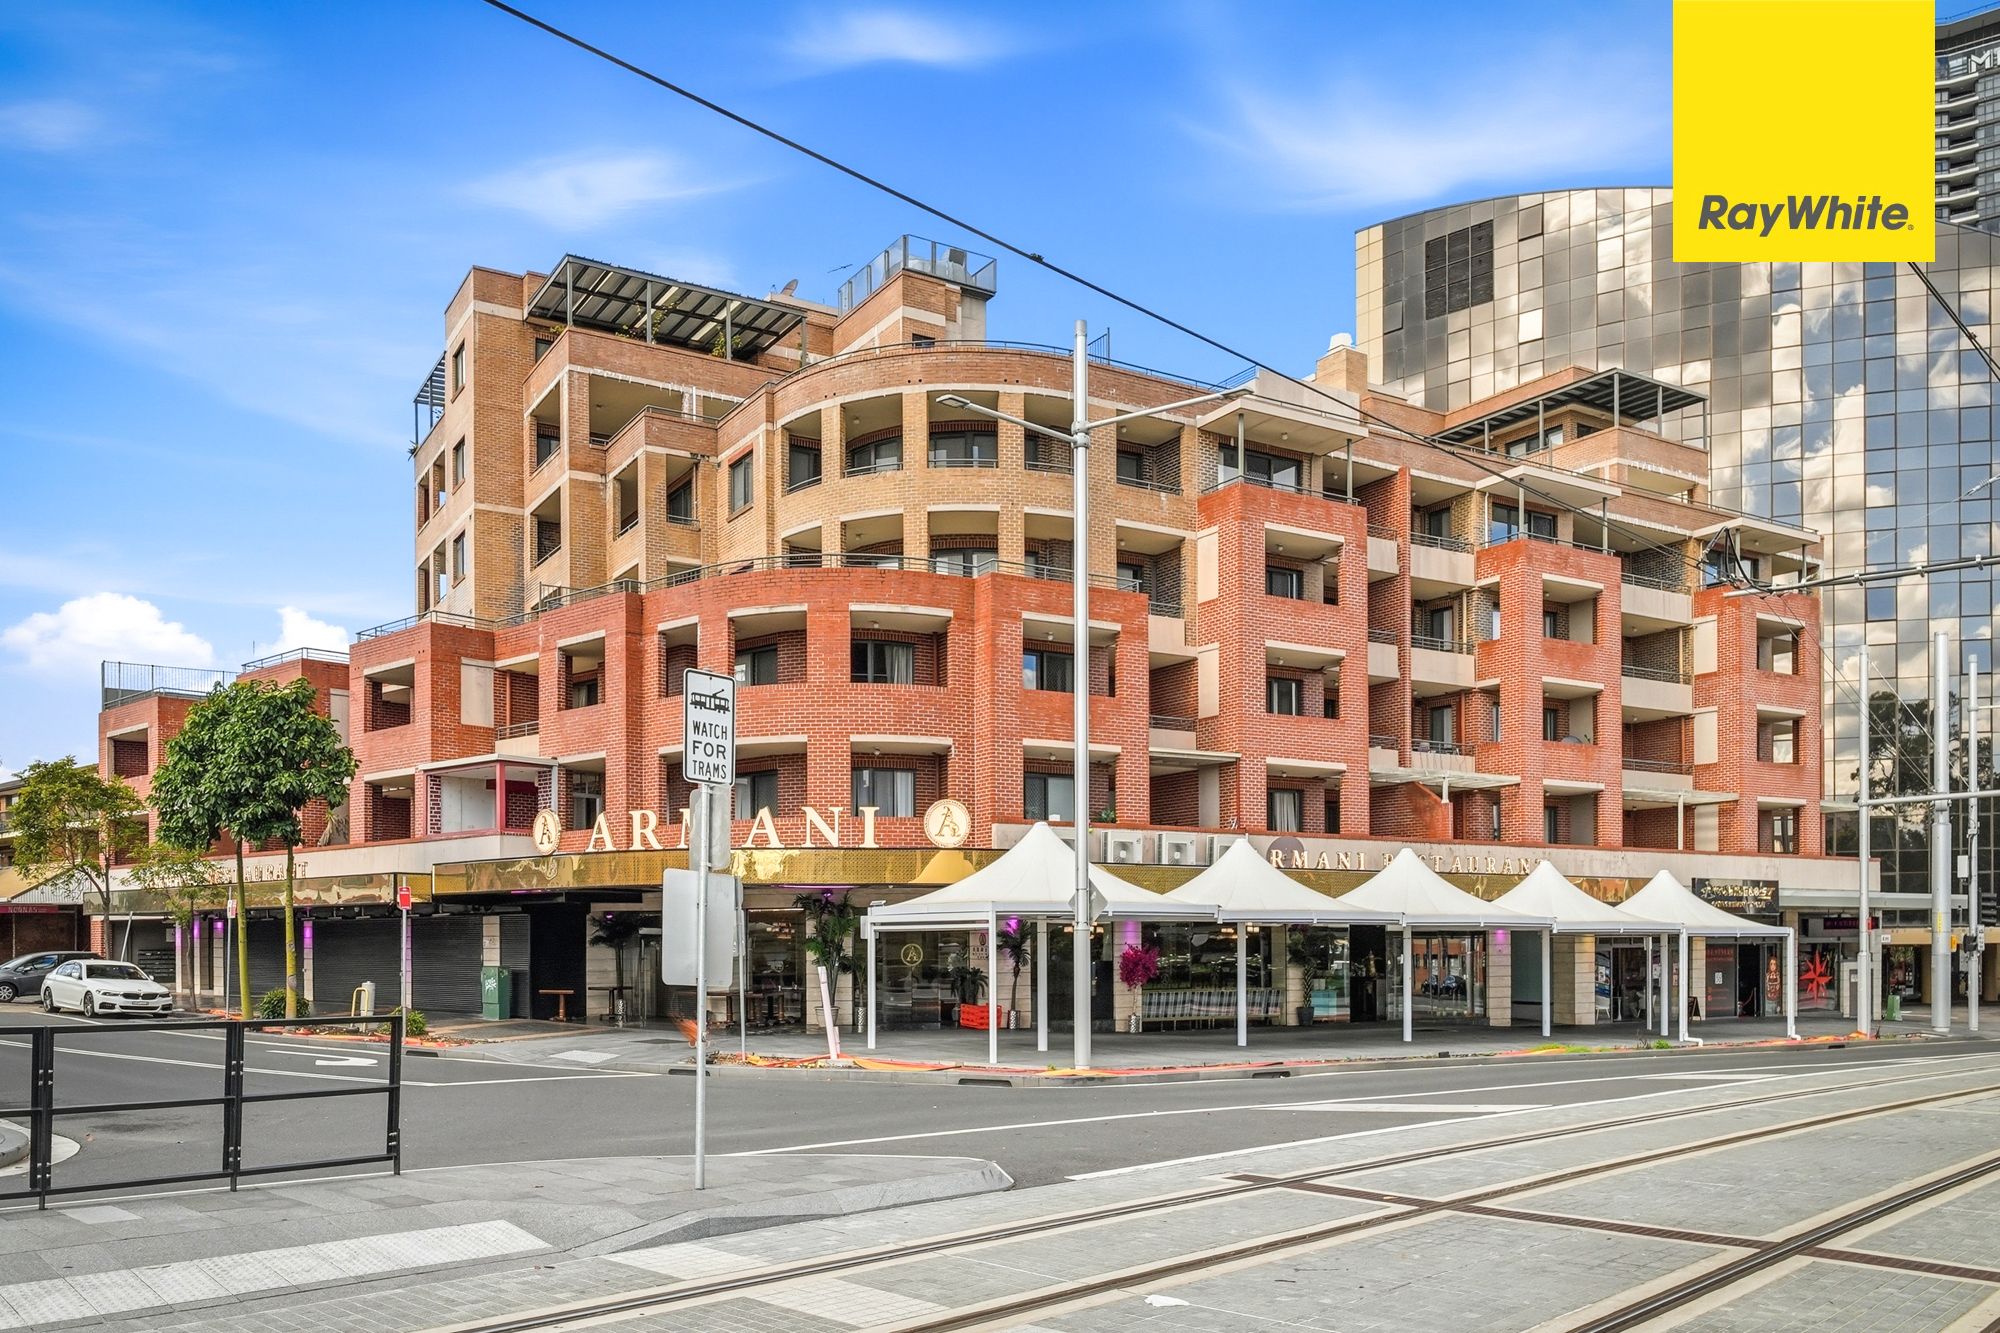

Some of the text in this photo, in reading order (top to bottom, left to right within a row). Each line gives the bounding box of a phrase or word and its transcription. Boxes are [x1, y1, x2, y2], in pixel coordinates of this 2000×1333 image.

[692, 719, 728, 740] WATCH
[692, 740, 727, 760] FOR
[692, 760, 727, 780] TRAMS
[1269, 848, 1543, 876] RMANI RTAURAN
